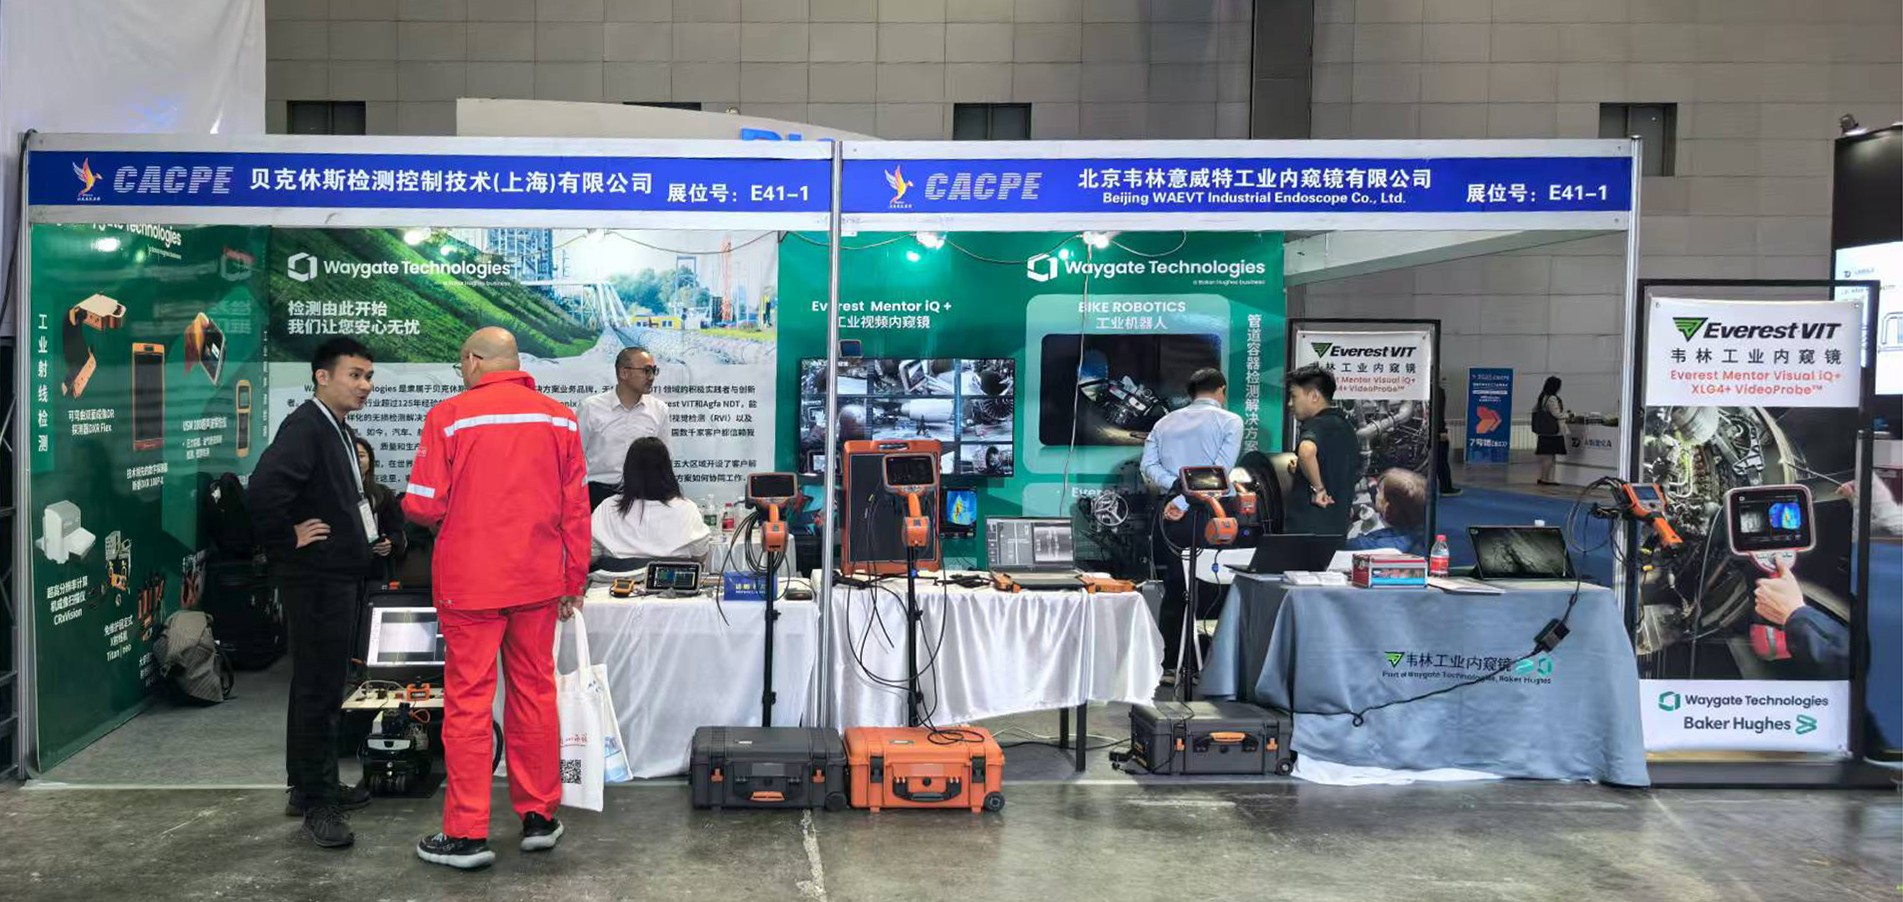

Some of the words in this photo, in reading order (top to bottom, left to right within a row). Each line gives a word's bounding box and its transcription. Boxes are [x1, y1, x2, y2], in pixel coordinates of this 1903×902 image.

[113, 166, 234, 195] CACPE
[250, 168, 653, 195] 贝克休斯检测控制技术(上海)有限公司
[924, 172, 1043, 200] CACPE
[1078, 168, 1432, 189] 北京韦林意威特工业内窥镜有限公司
[1103, 191, 1149, 206] Beijing
[1152, 192, 1204, 204] WAEVT
[1208, 191, 1271, 204] Industrial
[1275, 192, 1347, 206] Endoscope
[1351, 192, 1377, 206] Co.,
[1381, 192, 1406, 204] Ltd.
[323, 260, 399, 278] Waygate
[401, 260, 511, 279] Technologies
[1064, 260, 1145, 279] Waygate
[1149, 260, 1266, 279] Technologies
[288, 301, 387, 317] 检测由此开始
[812, 301, 864, 312] Evrest
[870, 301, 922, 312] Mentor
[924, 300, 940, 314] iQ
[1078, 301, 1110, 313] BIKE
[1112, 301, 1186, 313] ROBOTICS
[288, 318, 420, 335] 我们让您安心无忧
[1096, 316, 1168, 330] 工业机器人
[1703, 322, 1799, 339] Everest
[1801, 322, 1842, 339] VIT
[1330, 345, 1388, 357] Everest
[1390, 346, 1417, 357] VIT
[1671, 348, 1842, 364] 韦林工业内窥镜
[38, 314, 48, 452] 工业射线检测
[1670, 370, 1718, 380] Everest
[1723, 370, 1770, 380] Mentor
[1773, 370, 1815, 380] Visual
[1819, 370, 1841, 382] iQ+
[1691, 383, 1731, 394] XLG4+
[1685, 694, 1743, 708] Waygate
[1745, 694, 1829, 709] Technologies
[1683, 717, 1730, 730] Baker
[1733, 717, 1791, 734] Hughes
